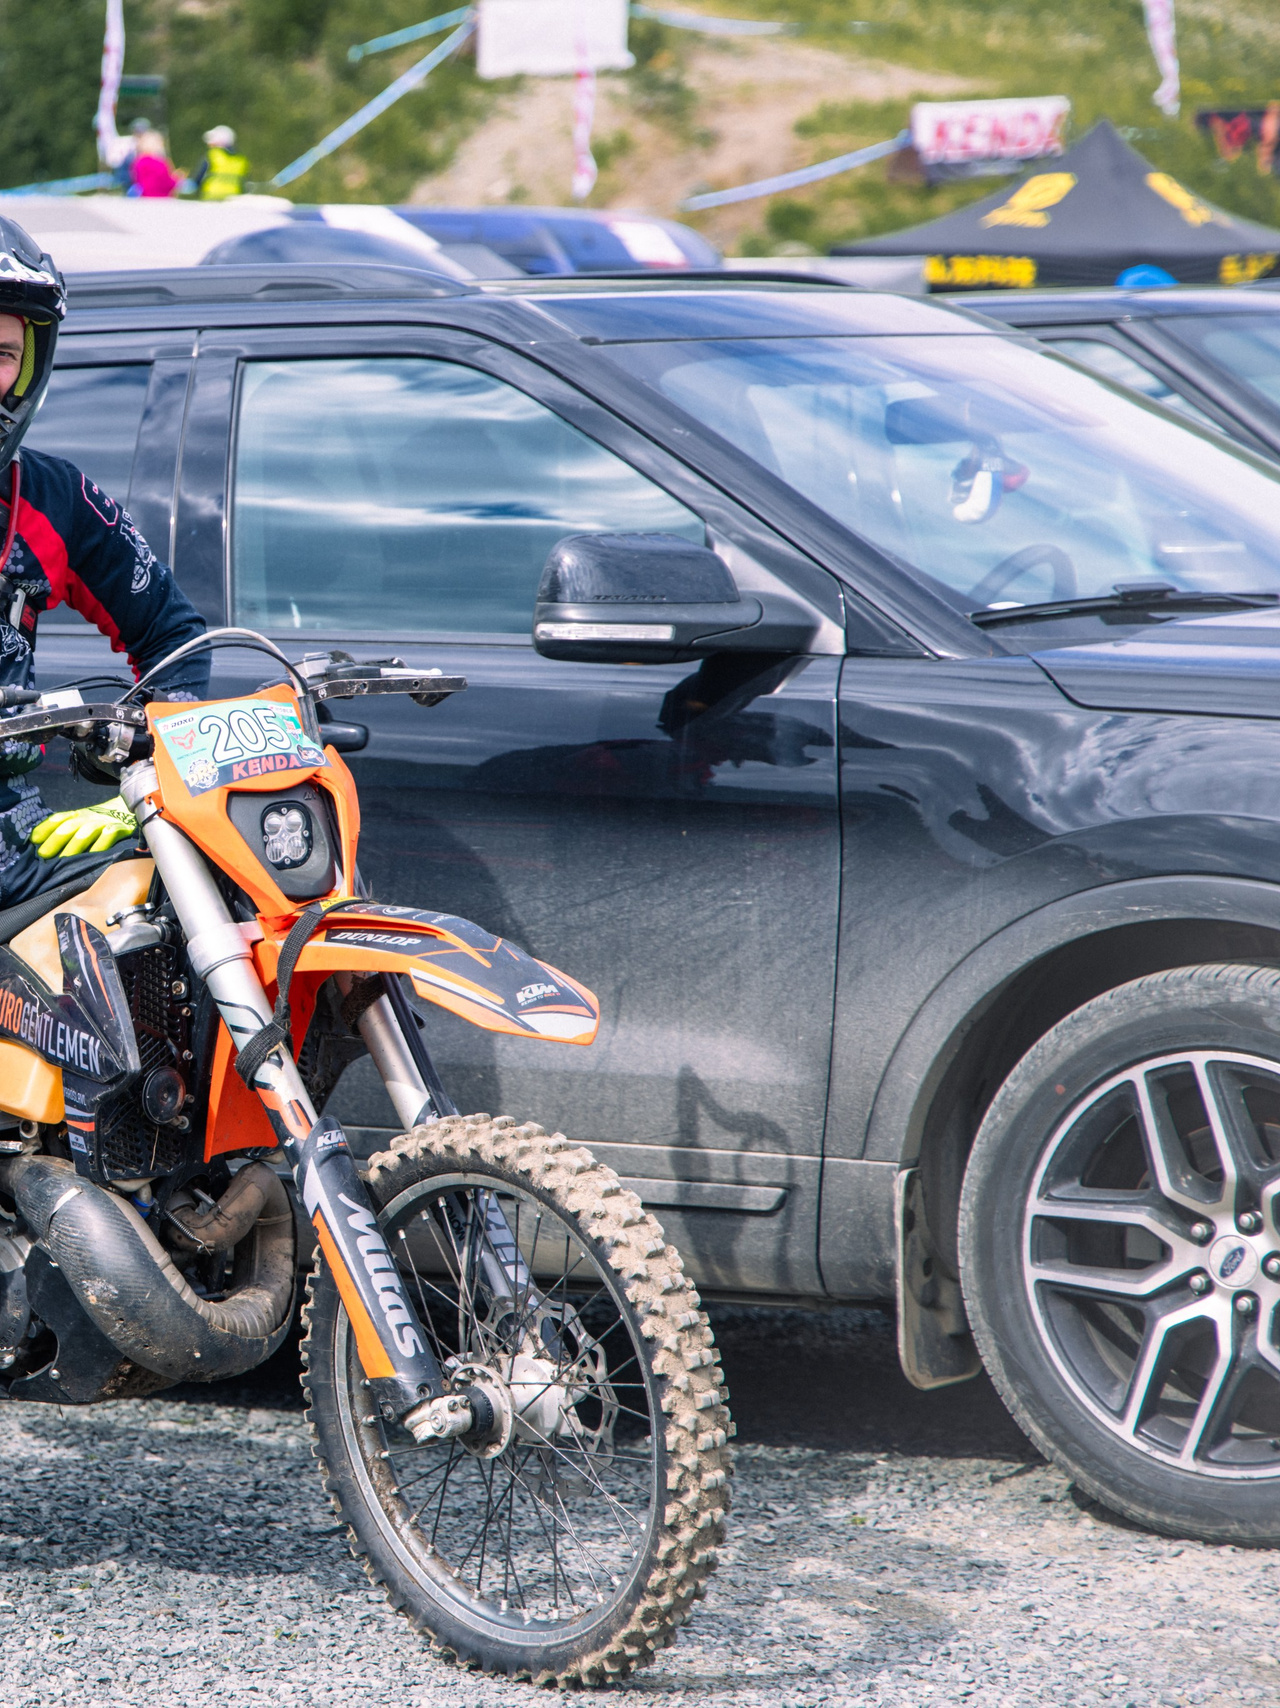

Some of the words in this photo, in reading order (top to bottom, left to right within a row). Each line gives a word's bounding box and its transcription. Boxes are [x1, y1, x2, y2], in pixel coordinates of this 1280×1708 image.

[198, 708, 292, 764] 205
[232, 754, 302, 780] KENDA
[331, 932, 422, 946] DUNLOP
[516, 983, 559, 1003] KTM
[337, 1192, 425, 1359] Mitas
